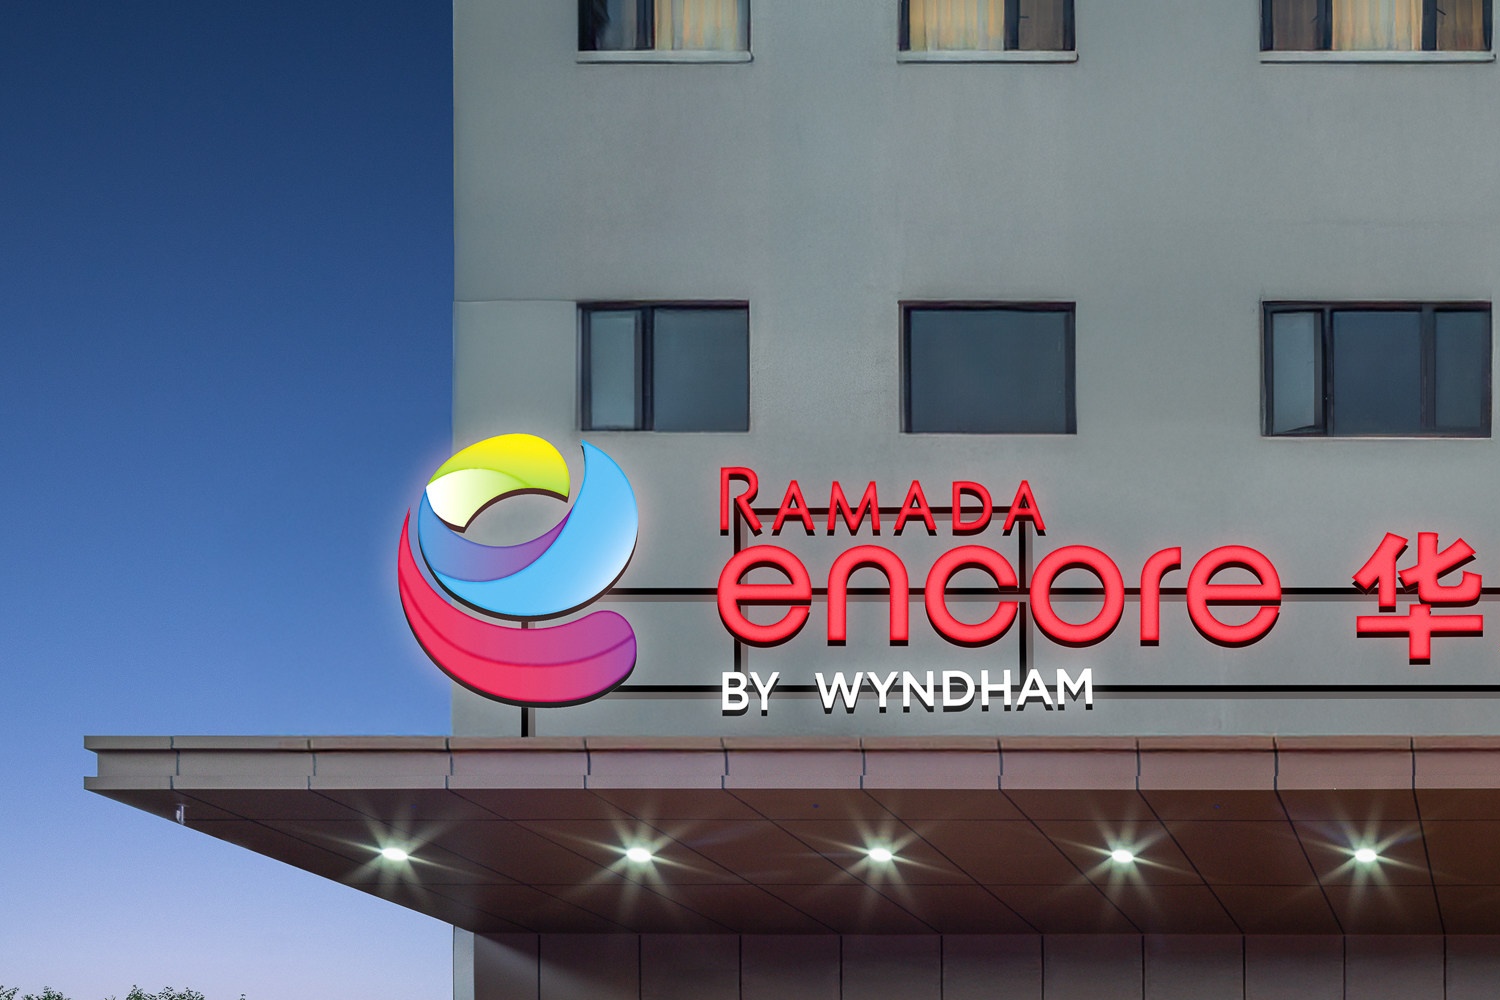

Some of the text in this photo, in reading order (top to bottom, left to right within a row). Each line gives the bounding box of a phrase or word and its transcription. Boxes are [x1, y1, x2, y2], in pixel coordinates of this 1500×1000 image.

[719, 466, 1047, 533] RAMADA
[717, 544, 1282, 645] encore
[721, 667, 1093, 712] BY WYNDHAM
